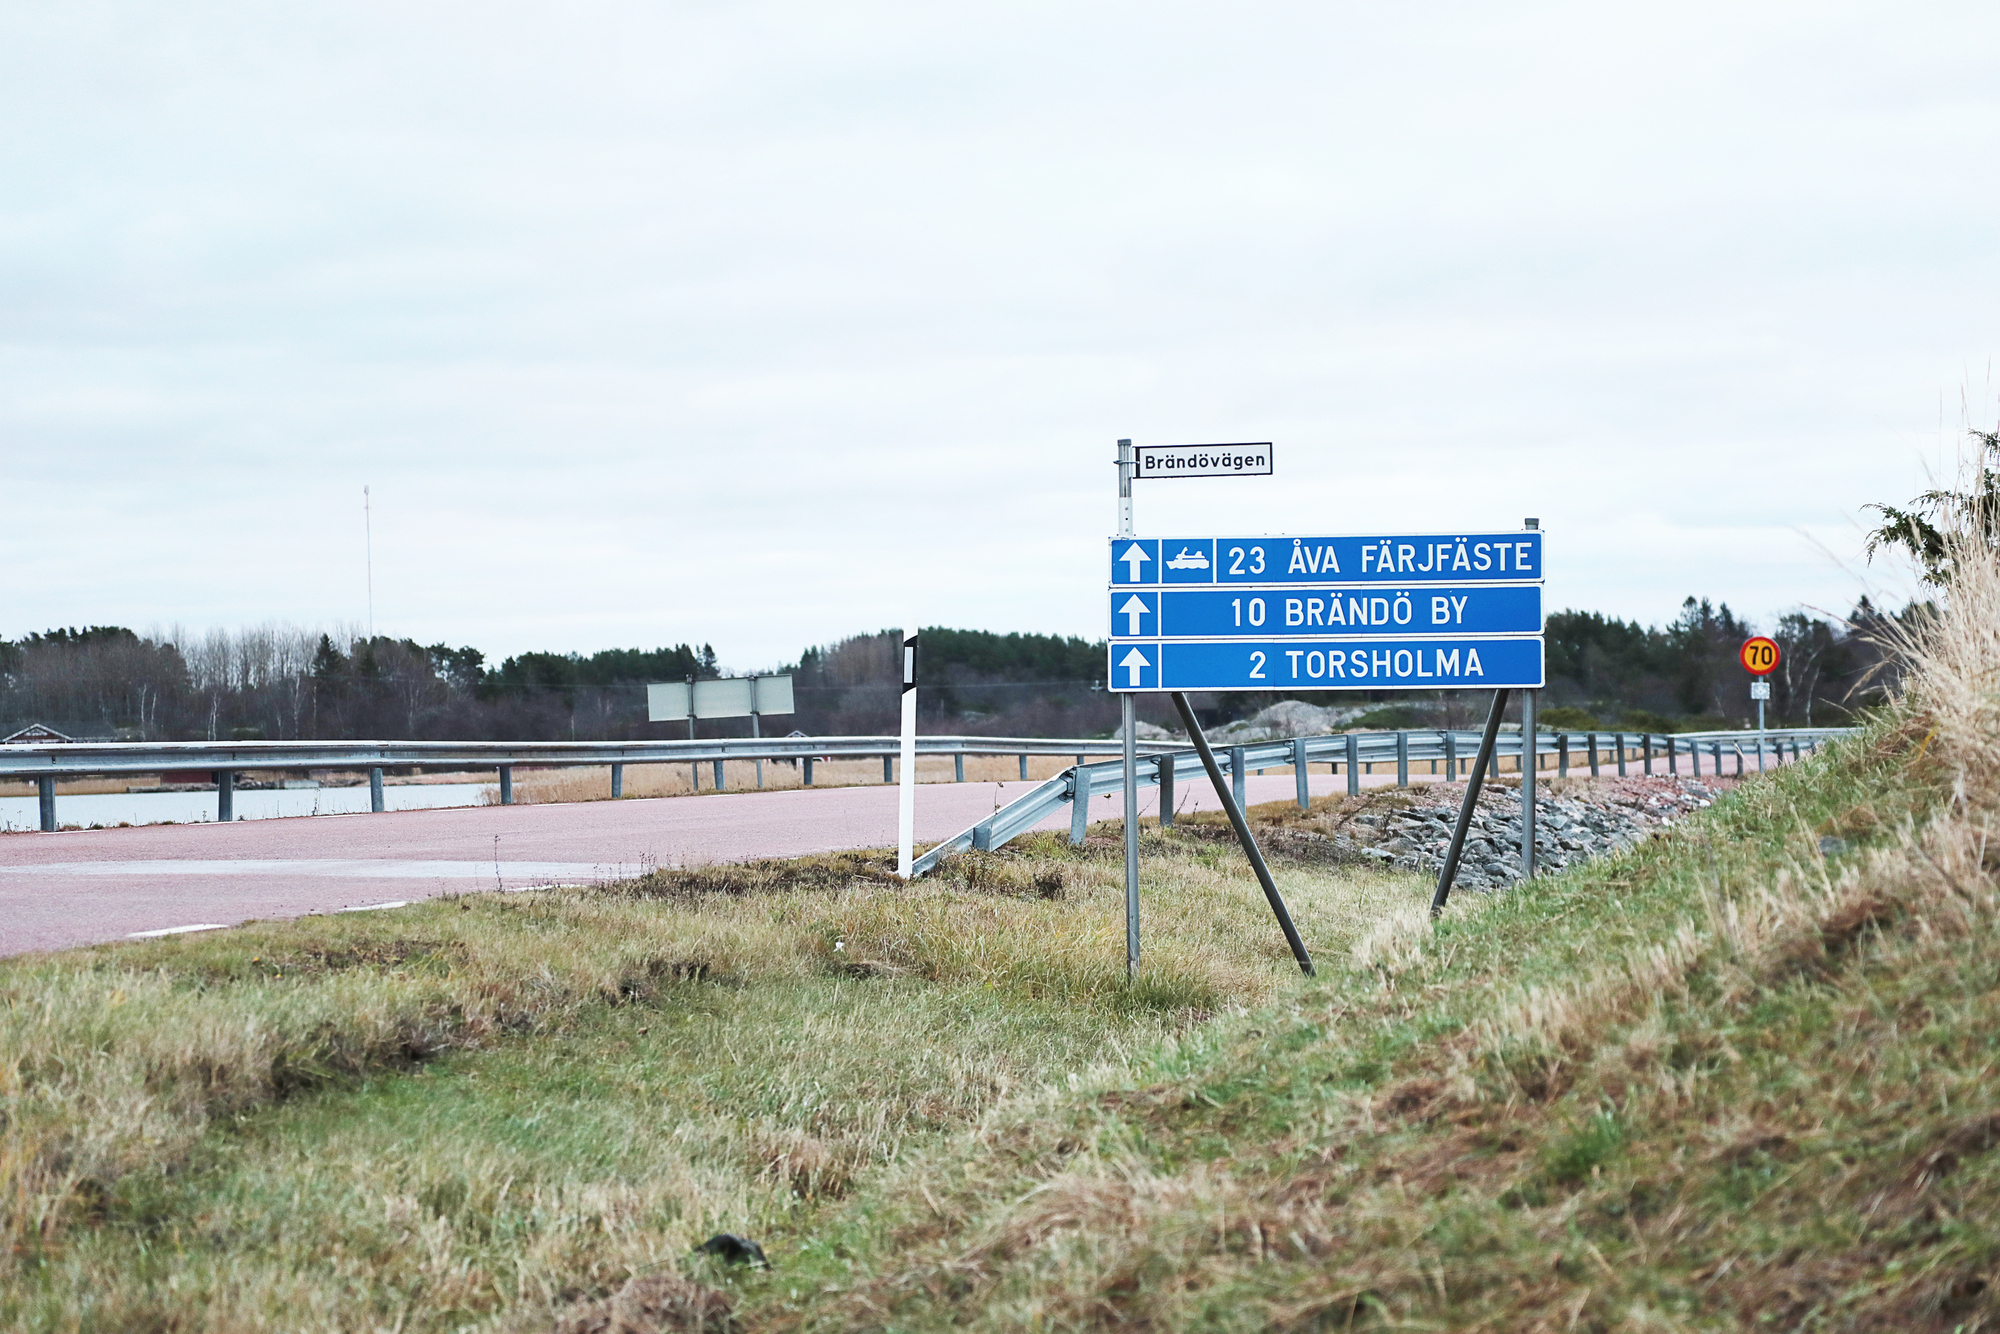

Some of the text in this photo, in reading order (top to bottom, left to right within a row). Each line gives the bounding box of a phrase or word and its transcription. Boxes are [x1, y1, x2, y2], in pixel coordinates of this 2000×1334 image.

[1145, 452, 1265, 471] Brändövägen
[1228, 536, 1533, 575] 23 ÅVA FÄRJFÄSTE
[1231, 591, 1468, 627] 10 BRÄNDÖ BY
[1249, 648, 1484, 679] 2 TORSHOLMA
[1749, 645, 1773, 666] 70
